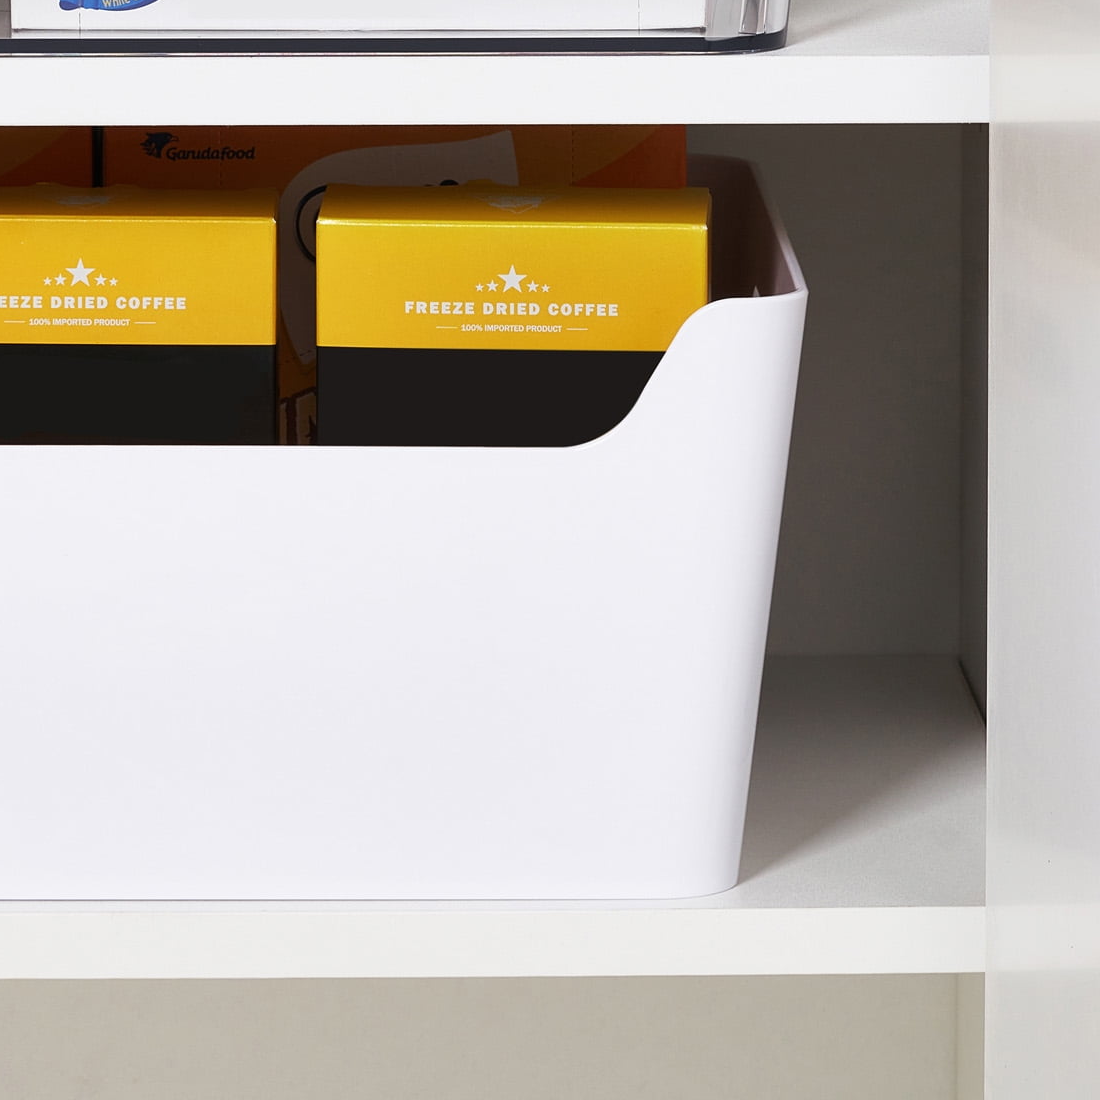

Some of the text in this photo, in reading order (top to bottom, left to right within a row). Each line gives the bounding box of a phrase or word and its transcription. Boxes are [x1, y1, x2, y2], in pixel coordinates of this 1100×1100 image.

[166, 144, 256, 161] Garudafood
[50, 295, 109, 310] DRIED
[115, 295, 187, 310] COFFEE
[404, 300, 619, 317] FREEZE DRIED COFFEE
[28, 317, 131, 327] 100% IMPORTED PRODUCT
[460, 323, 563, 333] 100% IMPORTED PRODUCT
